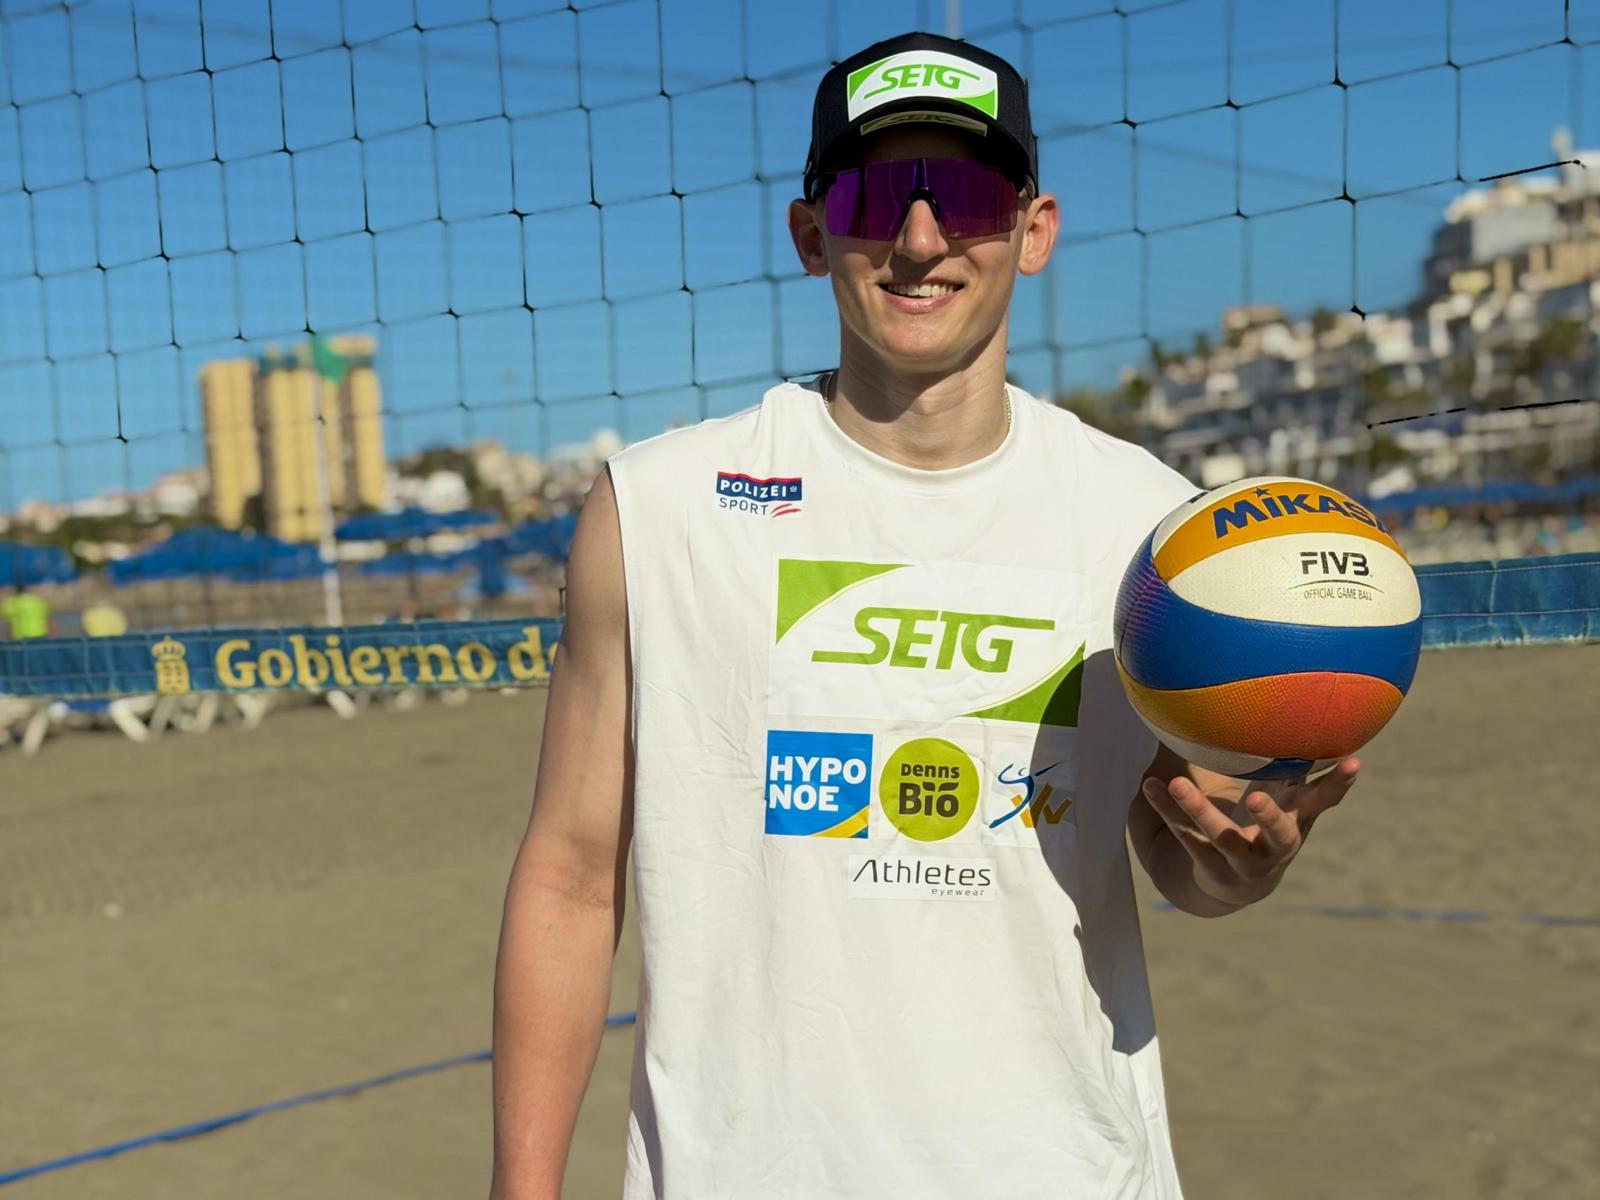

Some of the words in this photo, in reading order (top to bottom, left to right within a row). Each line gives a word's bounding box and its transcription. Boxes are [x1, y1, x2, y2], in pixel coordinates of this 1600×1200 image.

[864, 64, 981, 101] SETG
[720, 480, 787, 498] POLIZEI
[719, 498, 769, 515] SPORT
[1299, 551, 1370, 577] FIVB
[1304, 587, 1335, 600] OFFICIAL
[1337, 587, 1356, 600] GAME
[1358, 589, 1374, 601] BALL
[811, 606, 1056, 673] SETG
[215, 634, 496, 689] Gobierno
[508, 626, 559, 680] d
[770, 755, 867, 785] HYPO
[769, 784, 839, 812] NOE
[853, 859, 991, 887] Athletes
[931, 888, 985, 897] eyewear
